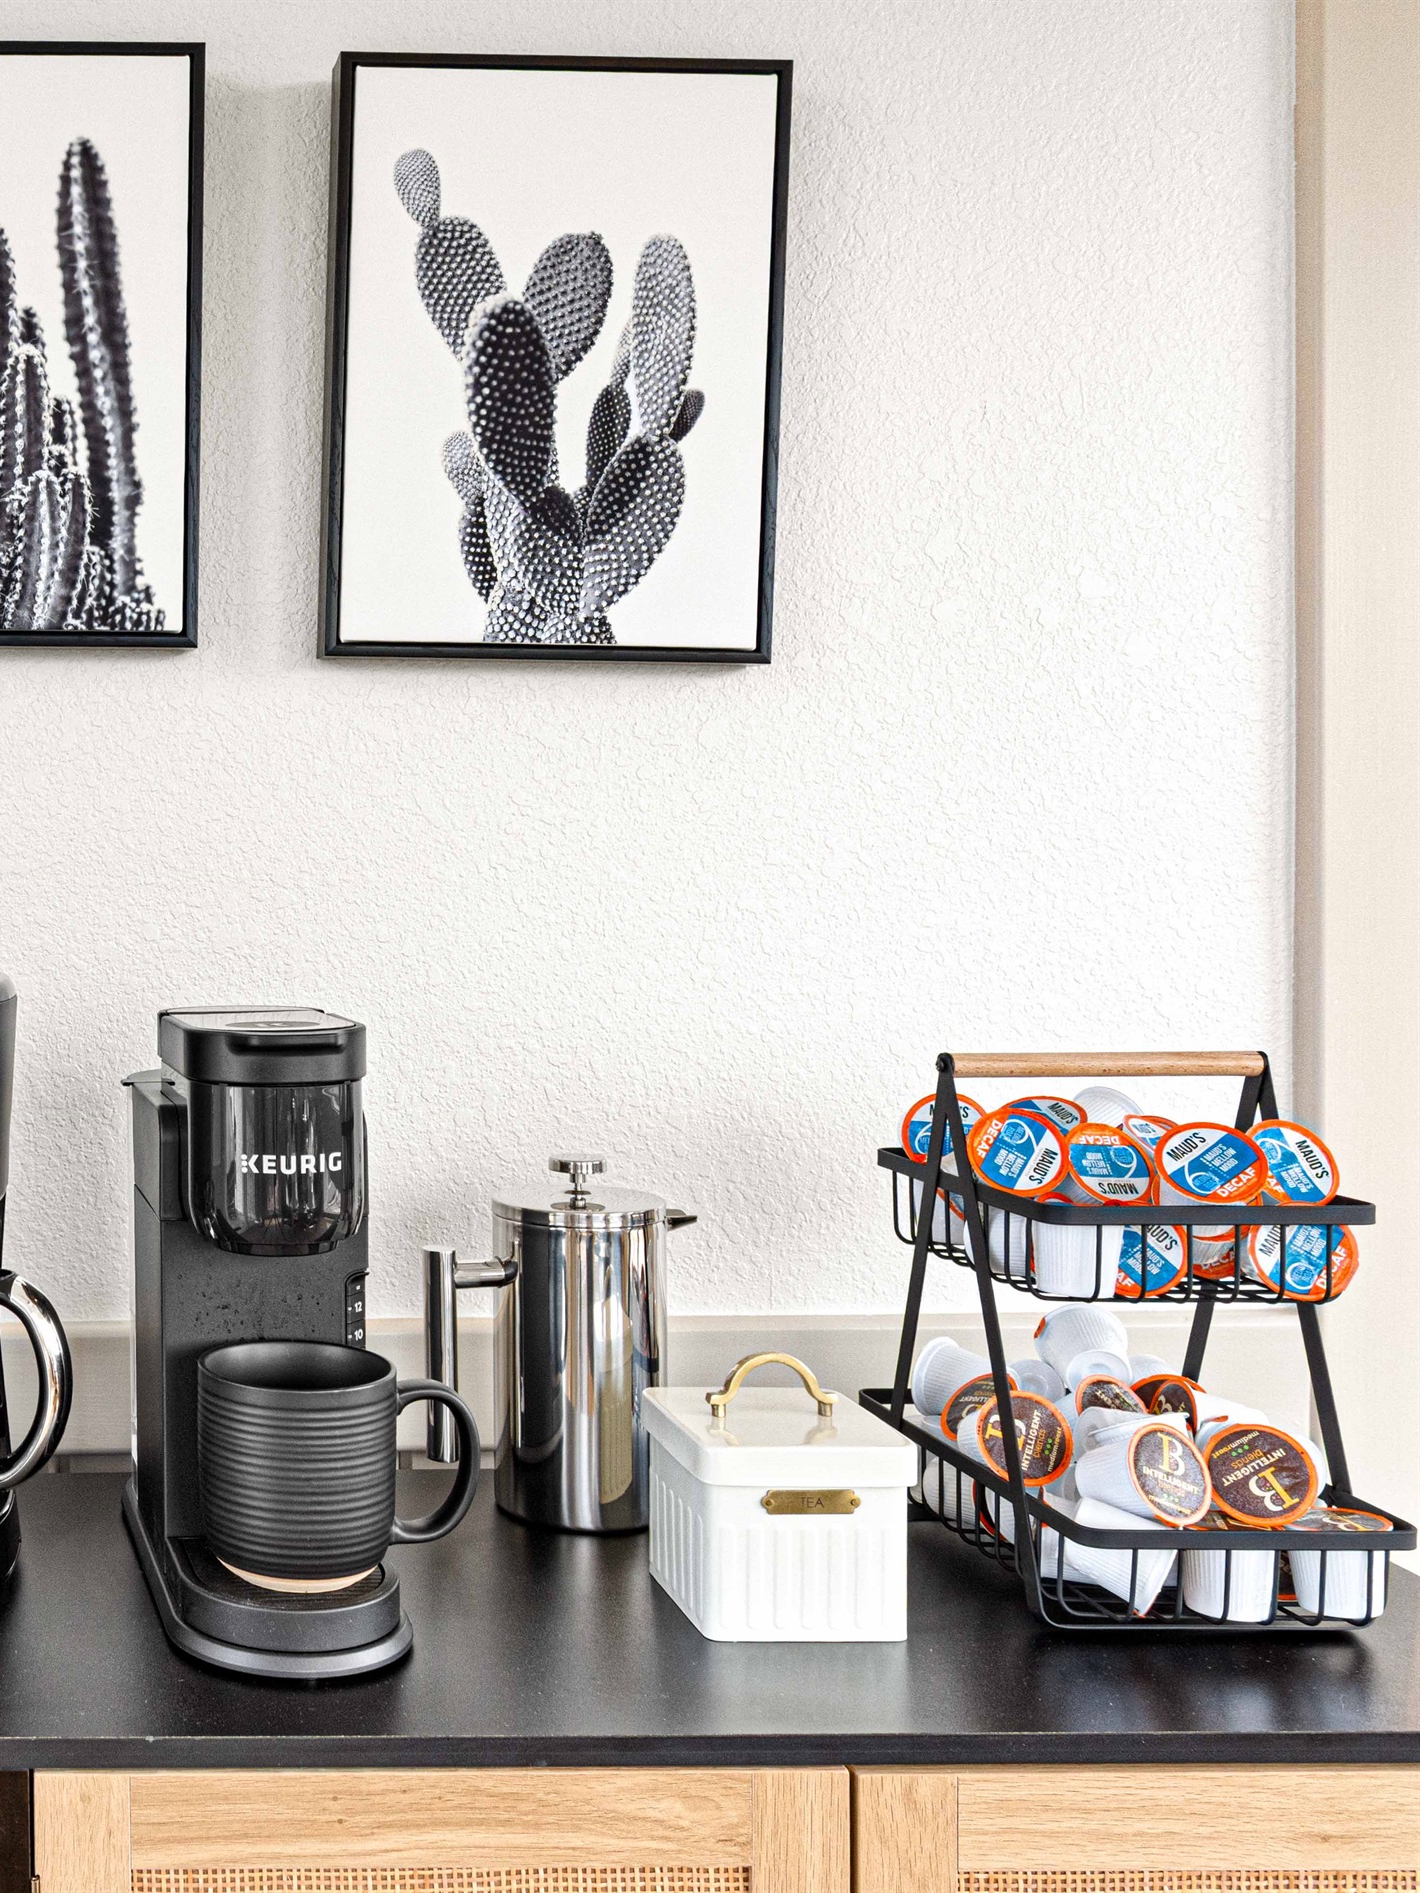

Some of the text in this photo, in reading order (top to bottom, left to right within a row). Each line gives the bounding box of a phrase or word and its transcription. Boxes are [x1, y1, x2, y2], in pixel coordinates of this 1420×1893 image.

[1047, 1102, 1078, 1124] MAUD'S
[976, 1119, 1003, 1159] DECAF
[1078, 1134, 1120, 1145] DECAF
[1166, 1132, 1206, 1161] MAUD'S
[1203, 1143, 1227, 1160] MAUD'S
[240, 1151, 342, 1175] KEURIG
[1027, 1147, 1059, 1185] MAUD'S
[1295, 1139, 1329, 1179] MAUD'S
[1098, 1182, 1139, 1195] MAUD'S
[1216, 1166, 1256, 1198] DECAF
[1146, 1225, 1178, 1251] AUD'S
[1201, 1250, 1236, 1270] DECA
[354, 1301, 363, 1313] 12
[354, 1328, 364, 1341] 10
[1021, 1409, 1042, 1471] INTELLIGENT
[1033, 1428, 1046, 1458] blends
[1221, 1447, 1286, 1487] INTELLIGENT
[1230, 1448, 1264, 1470] blends
[1142, 1466, 1200, 1495] INTELLIGENT
[800, 1496, 825, 1508] TEA
